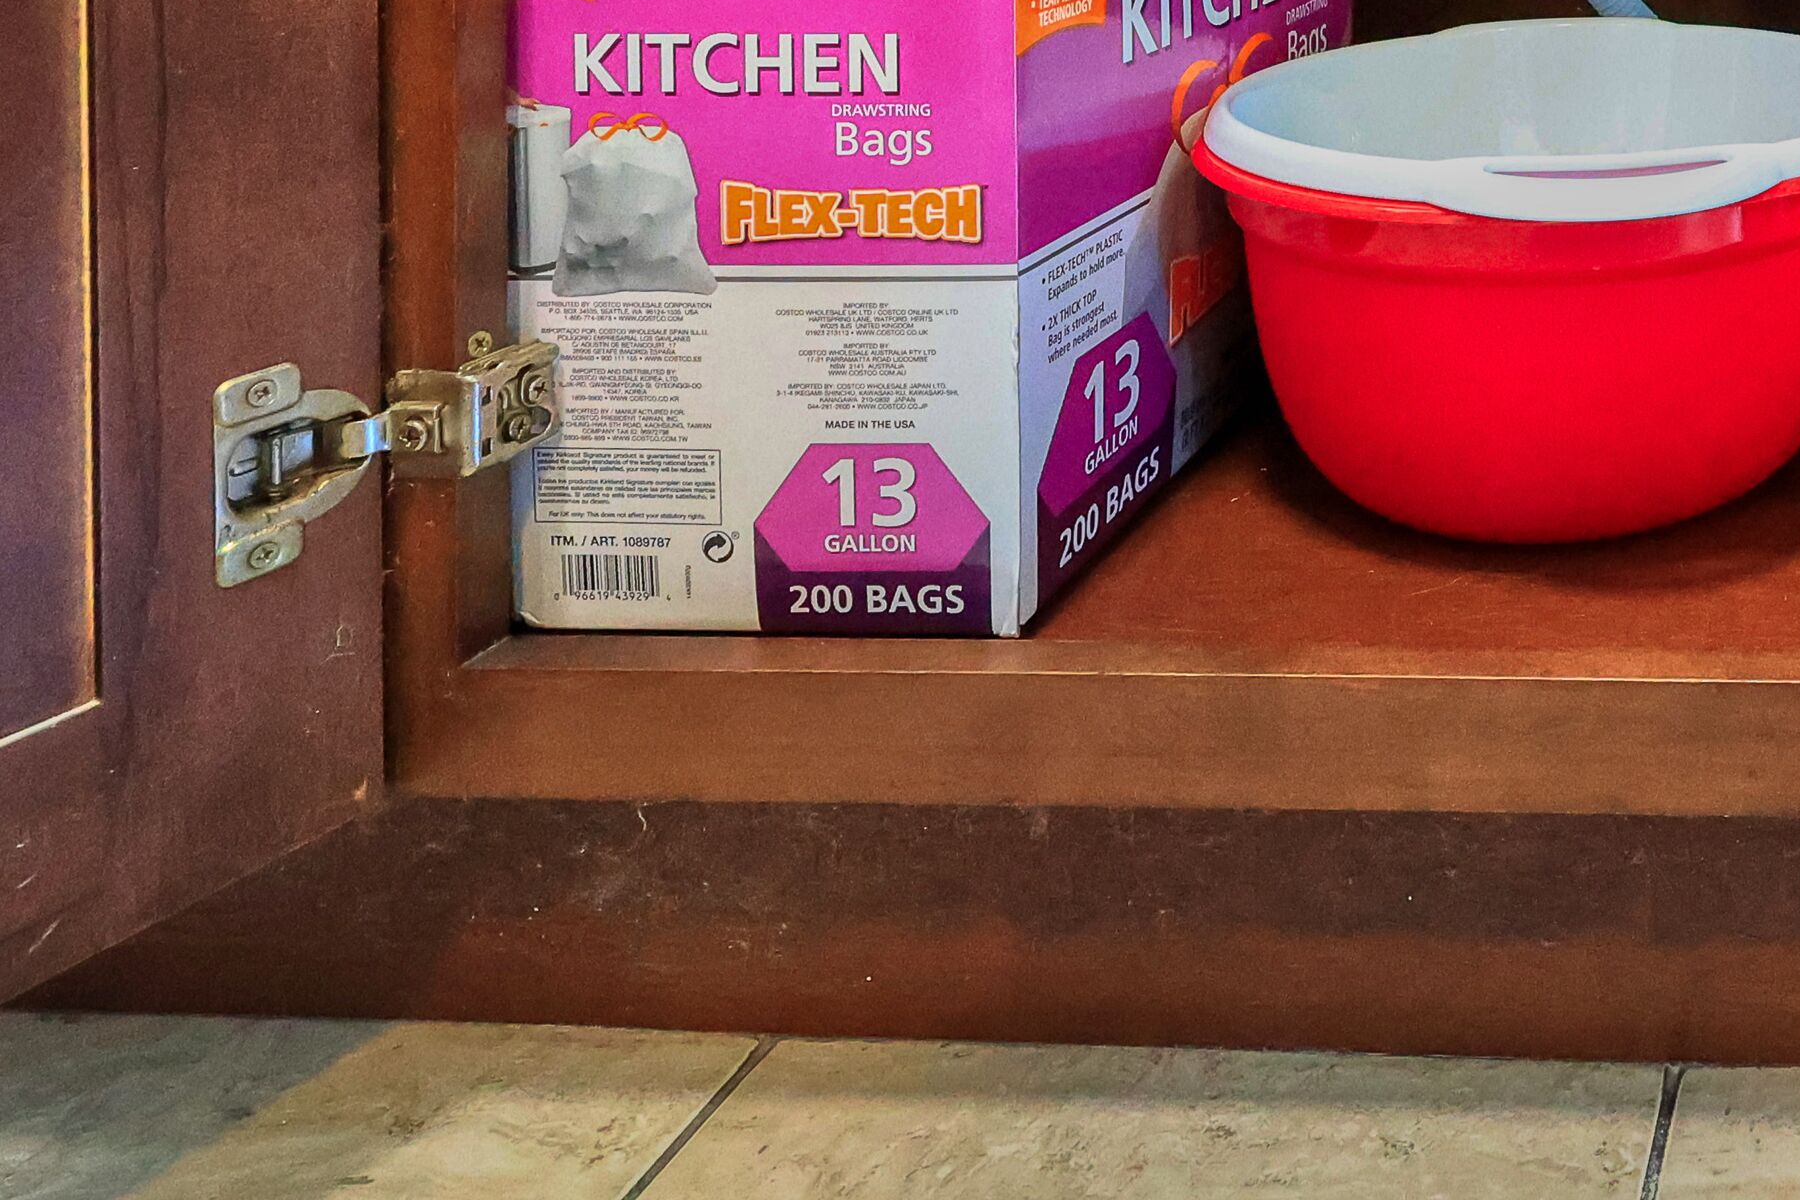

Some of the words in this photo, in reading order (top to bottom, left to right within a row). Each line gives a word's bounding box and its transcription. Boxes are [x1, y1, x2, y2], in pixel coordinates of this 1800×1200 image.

[573, 33, 900, 94] KITCHEN
[831, 103, 932, 118] DRAWSTRING
[835, 121, 933, 166] Bags
[720, 178, 983, 245] FLEX-TECH
[1095, 229, 1123, 255] PLASTIC
[1048, 272, 1078, 301] Expands
[1080, 270, 1088, 282] to
[1089, 258, 1105, 277] hold
[1106, 247, 1125, 267] more.
[1048, 312, 1059, 330] 2X
[1060, 298, 1081, 323] THICK
[1083, 288, 1097, 308] TOP
[1048, 331, 1063, 348] Bag
[1064, 324, 1071, 337] is
[1072, 301, 1105, 333] strongest
[1048, 341, 1071, 364] where
[1072, 320, 1099, 347] needed
[1100, 309, 1119, 329] most.
[1083, 338, 1140, 445] 13
[825, 420, 856, 429] MADE
[857, 420, 869, 429] IN
[871, 420, 892, 429] THE
[893, 420, 916, 429] USA
[1084, 415, 1139, 476] GALLON
[821, 457, 918, 530] 13
[1059, 502, 1099, 570] 200
[1105, 446, 1160, 526] BAGS
[550, 535, 578, 547] ITM.
[581, 535, 587, 546] /
[590, 536, 619, 547] ART.
[622, 537, 672, 548] 1089787
[823, 533, 916, 555] GALLON
[554, 592, 560, 601] 0
[574, 591, 609, 601] 96619
[615, 591, 650, 602] 43929
[789, 584, 853, 614] 200
[866, 584, 965, 615] BAGS
